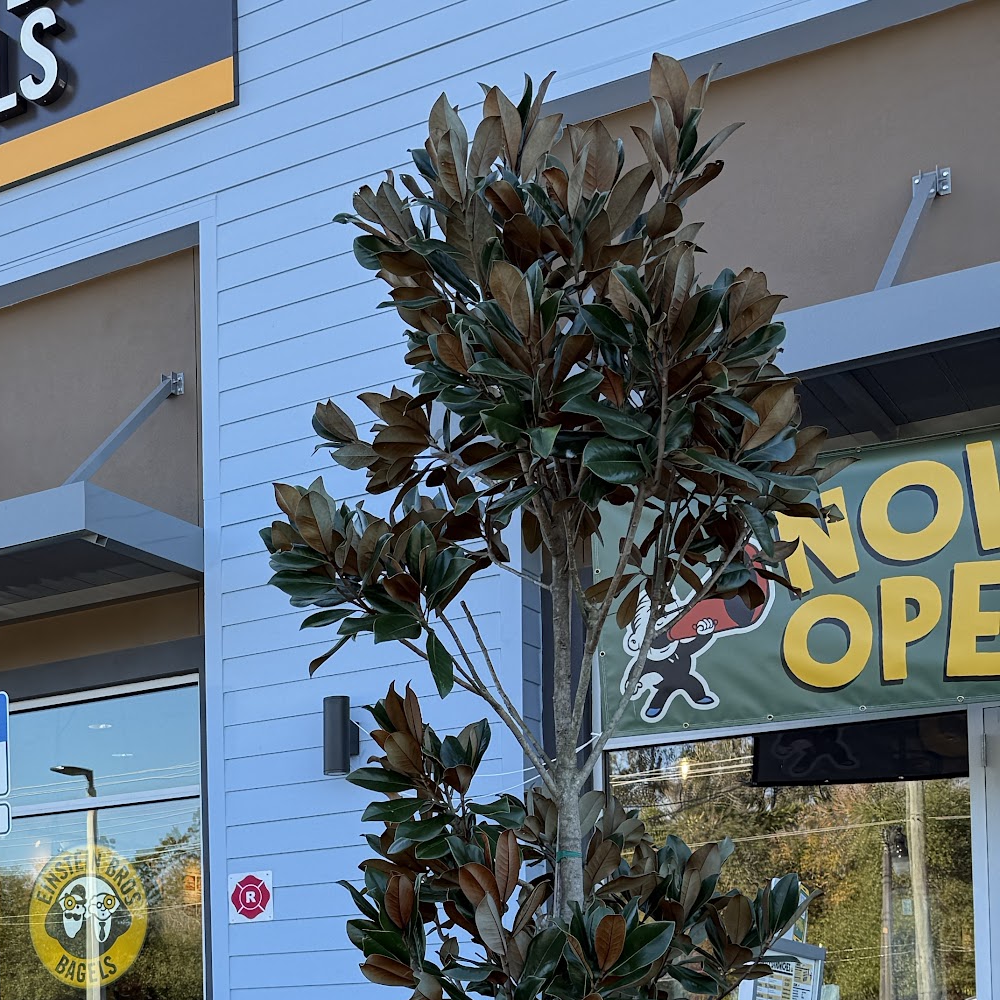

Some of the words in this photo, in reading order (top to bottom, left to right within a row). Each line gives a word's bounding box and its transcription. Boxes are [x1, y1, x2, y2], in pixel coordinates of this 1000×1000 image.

[775, 440, 1000, 594] NO
[104, 856, 142, 907] BROS
[245, 891, 257, 904] R
[55, 954, 118, 983] BAGELS
